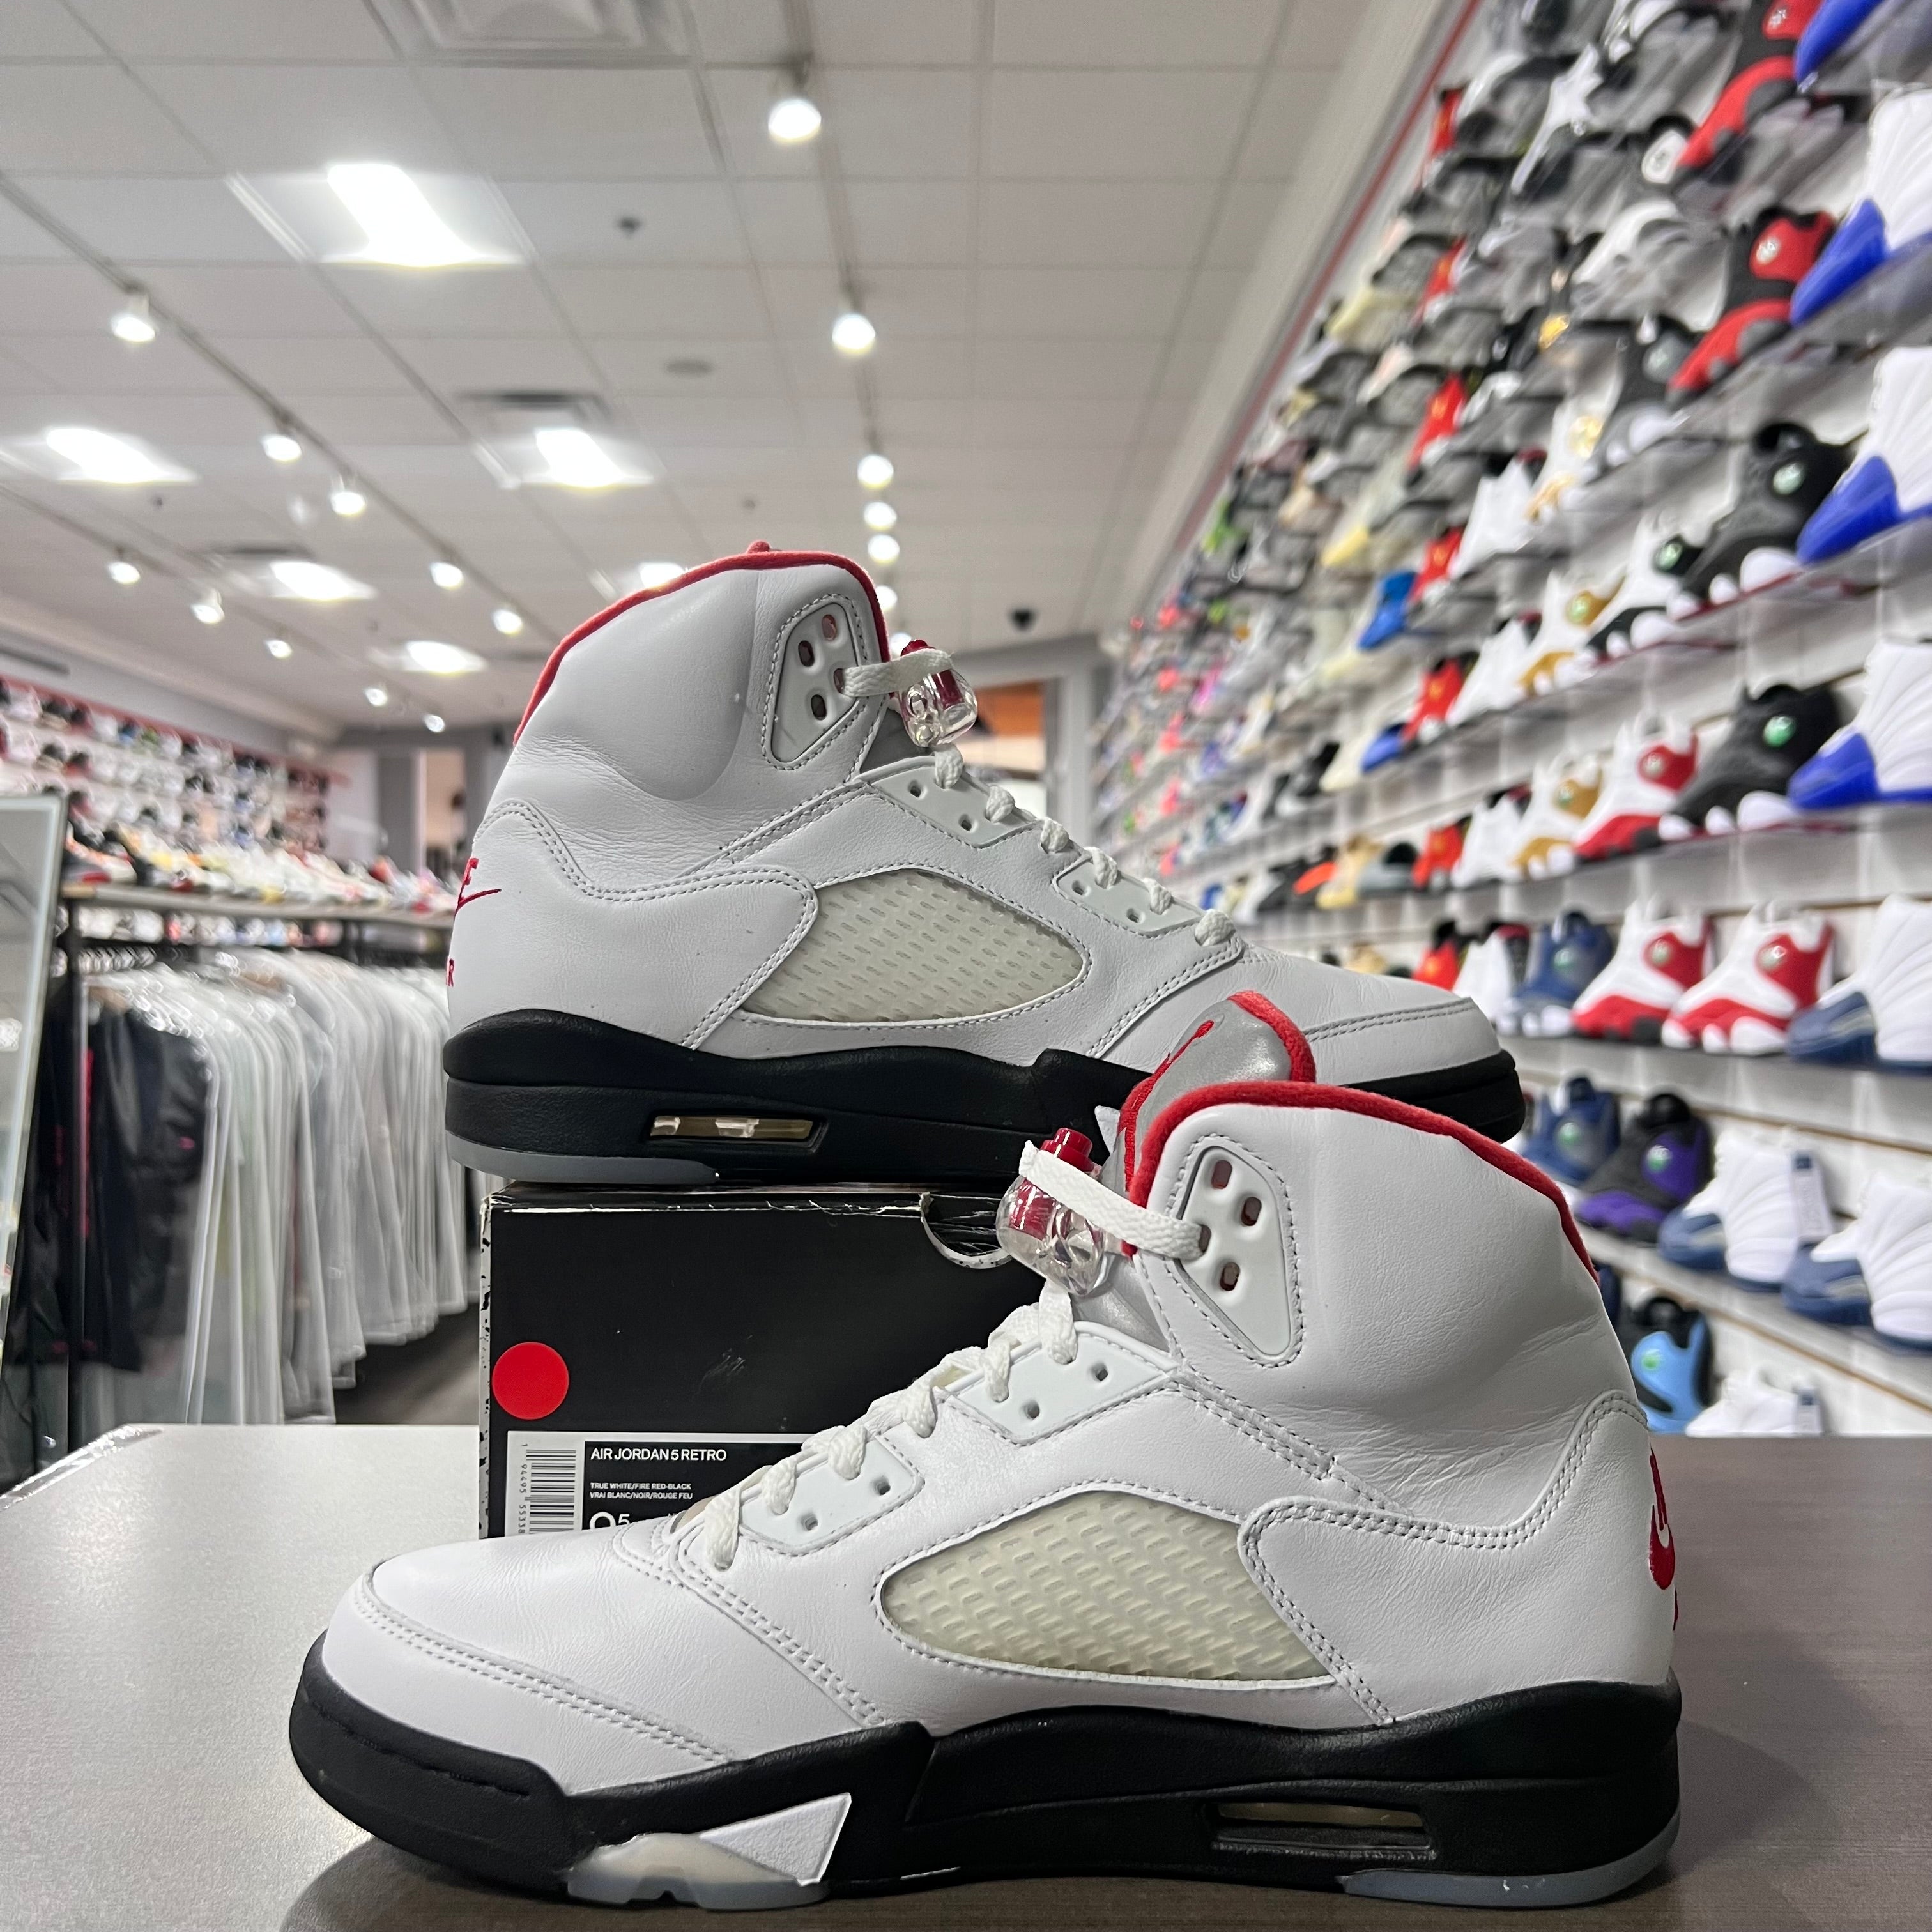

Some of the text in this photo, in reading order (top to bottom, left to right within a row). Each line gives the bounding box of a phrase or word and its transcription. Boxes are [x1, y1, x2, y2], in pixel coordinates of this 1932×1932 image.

[591, 1448, 727, 1461] AIR JORDAN 5 RETRO
[518, 1505, 526, 1534] 55338
